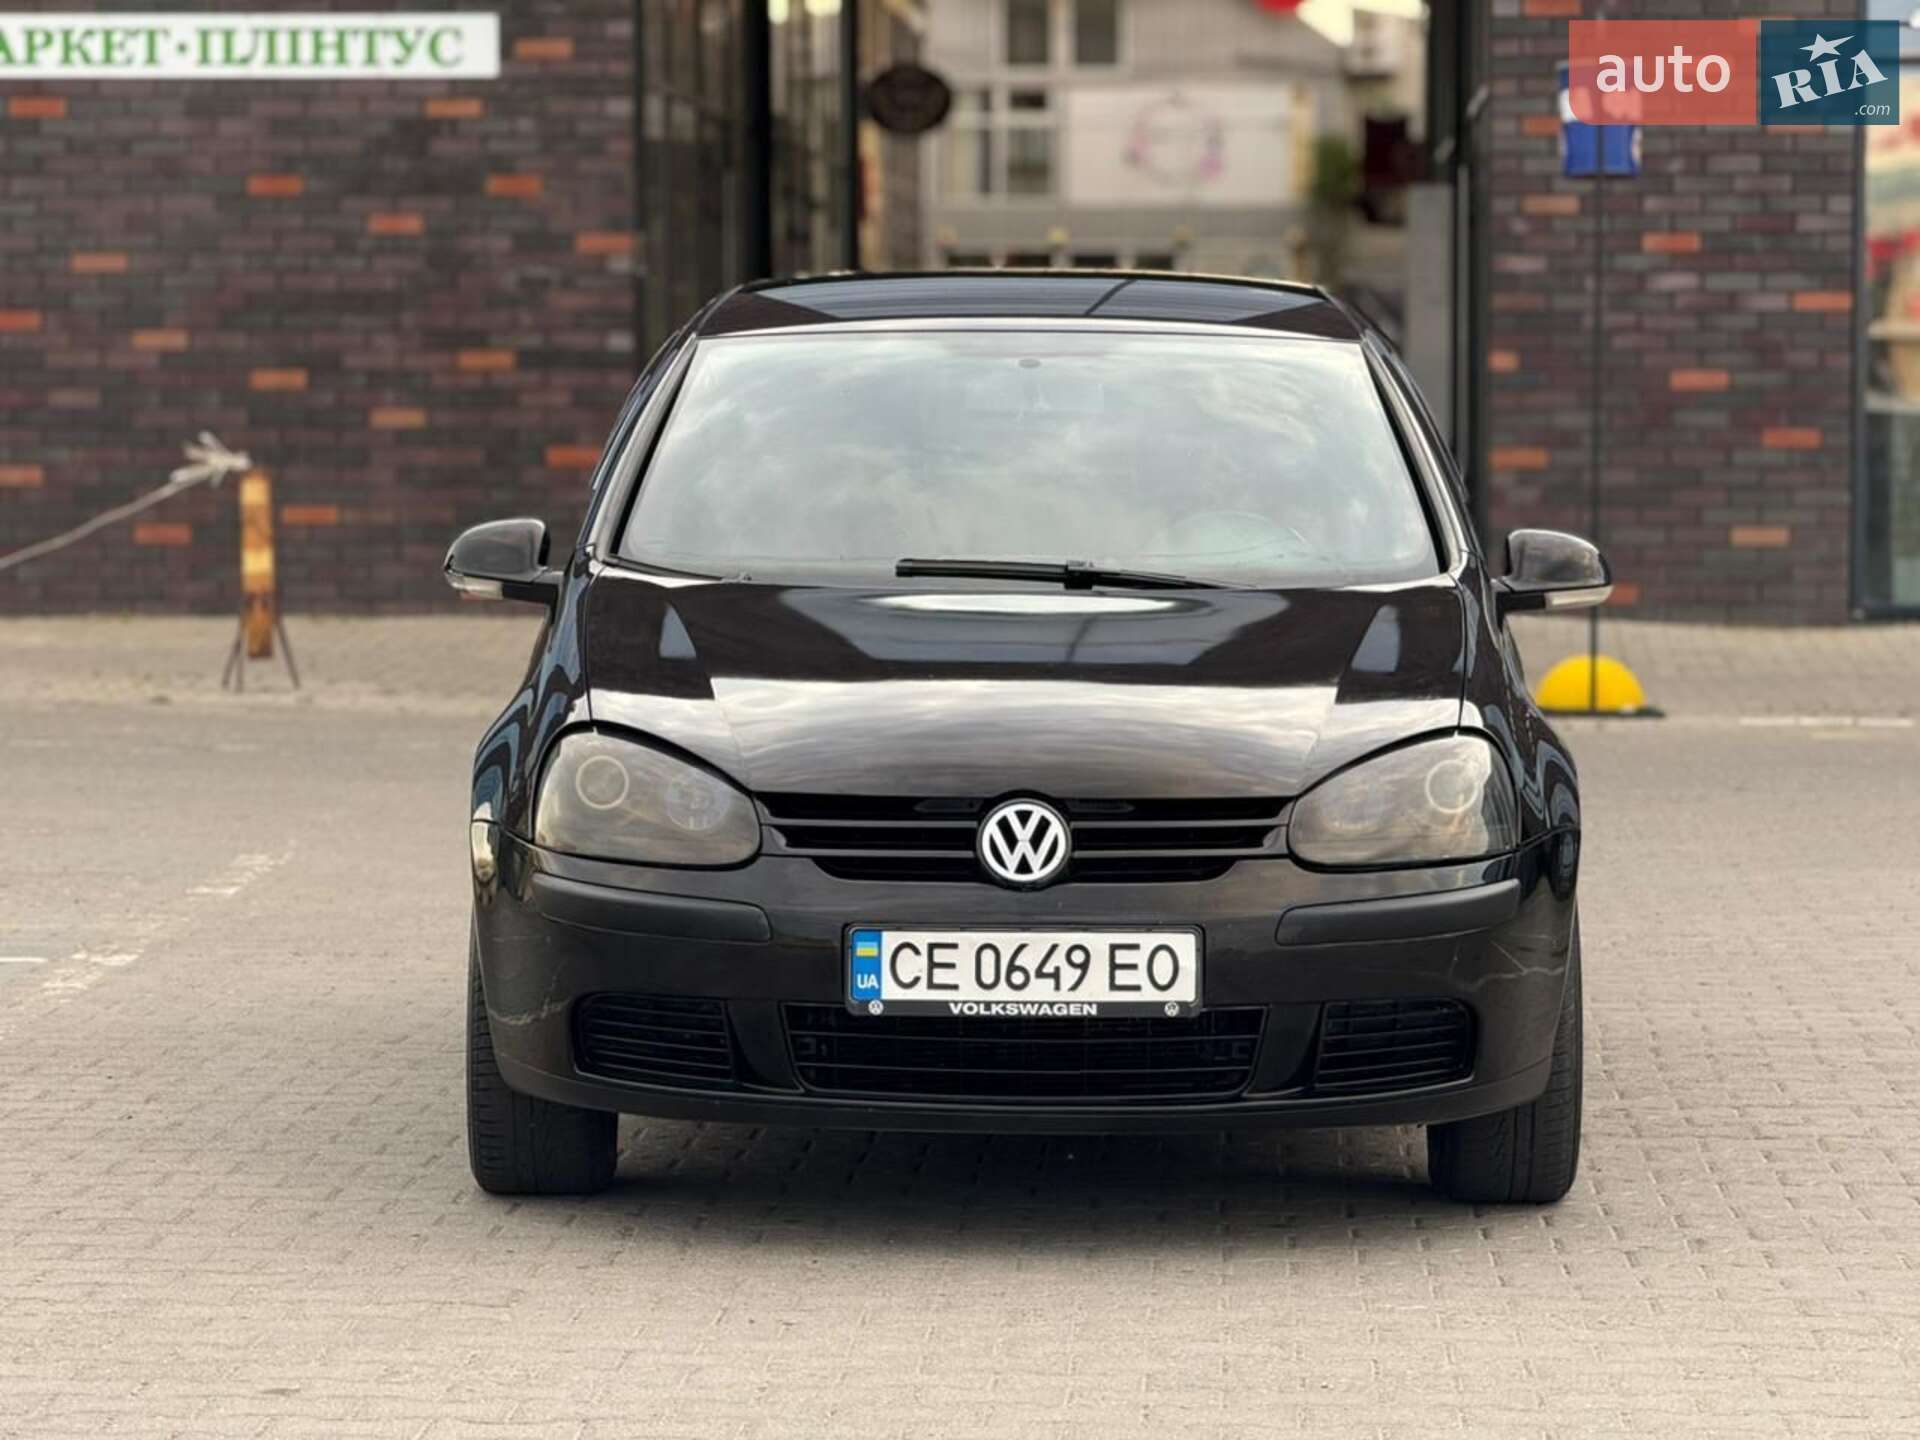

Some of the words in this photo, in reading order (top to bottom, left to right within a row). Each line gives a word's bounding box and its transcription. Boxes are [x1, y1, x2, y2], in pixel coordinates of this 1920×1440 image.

[889, 941, 961, 991] CE
[974, 942, 1091, 992] 0649
[1108, 942, 1181, 992] EO
[856, 974, 879, 989] UA
[948, 1001, 1098, 1017] VOLKSWAGEN
